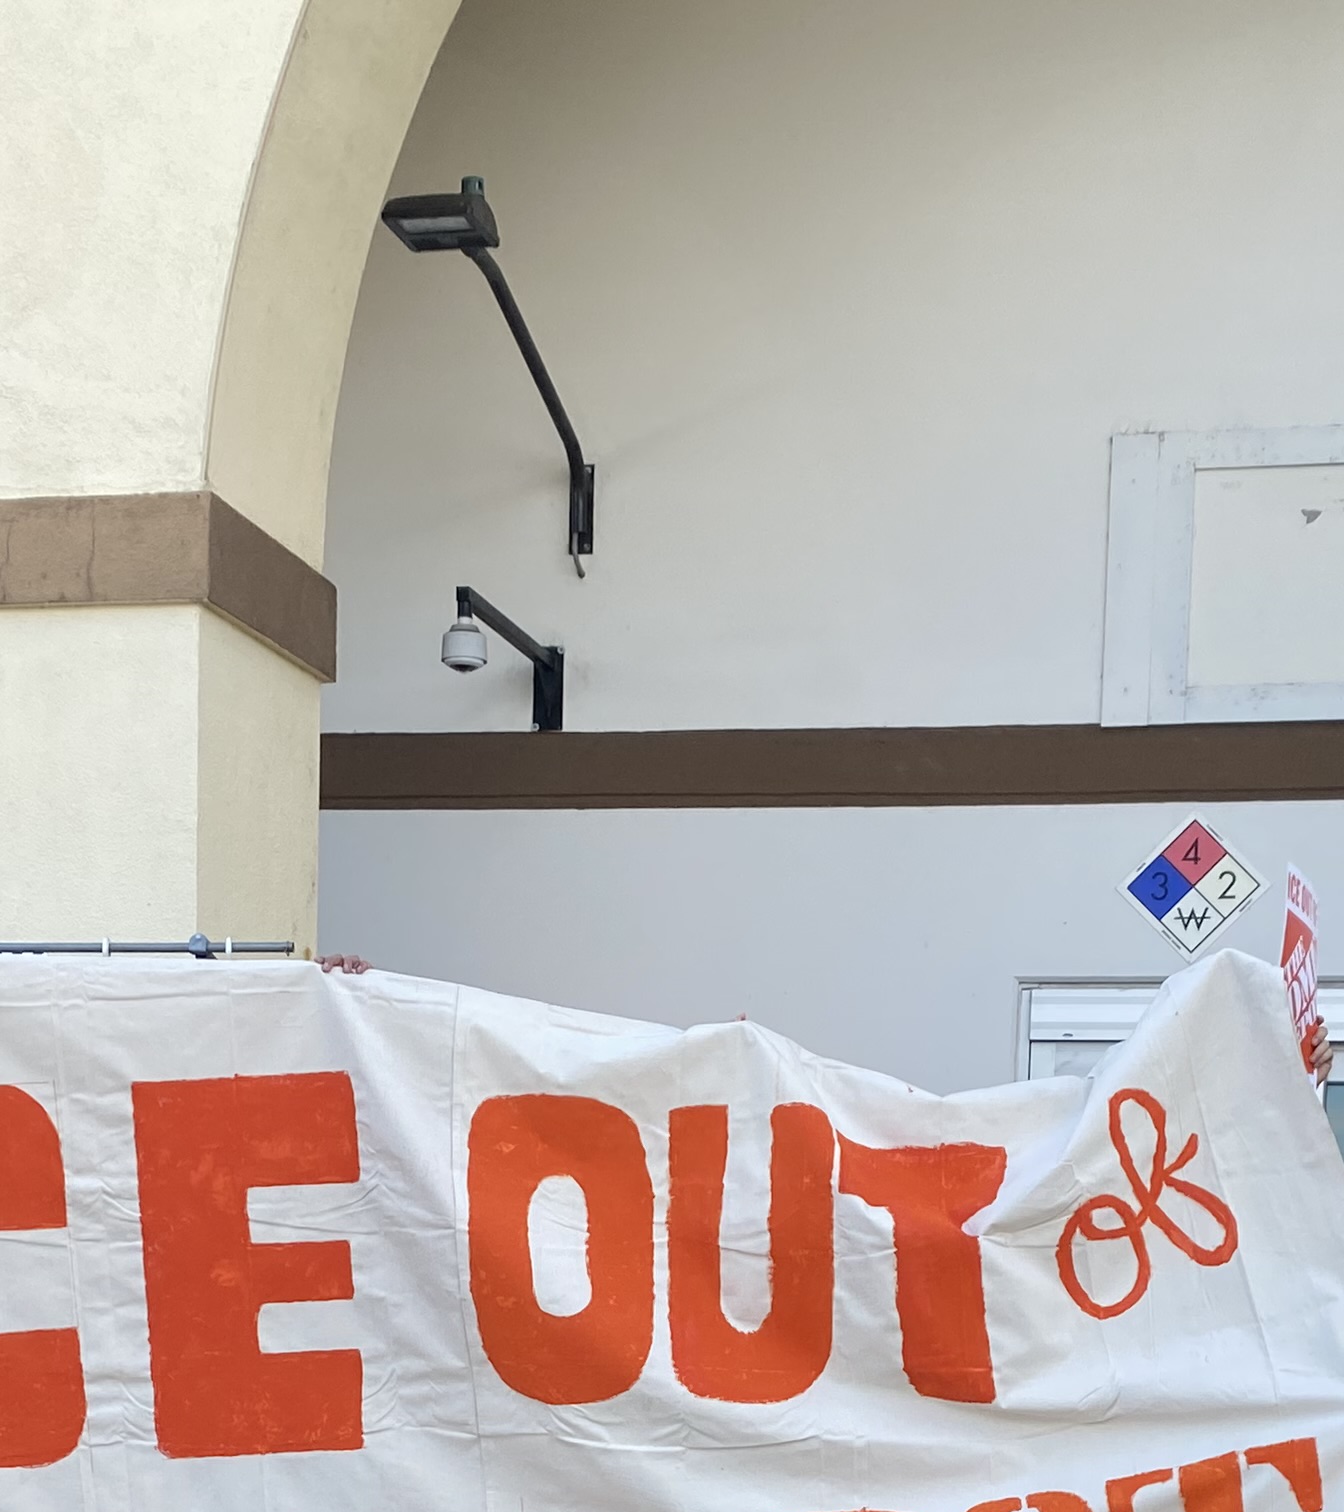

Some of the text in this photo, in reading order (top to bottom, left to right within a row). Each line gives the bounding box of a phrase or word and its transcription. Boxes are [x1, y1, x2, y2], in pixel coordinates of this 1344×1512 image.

[1181, 837, 1201, 865] 4
[1150, 871, 1236, 901] 3 2
[467, 1094, 1008, 1405] OUT
